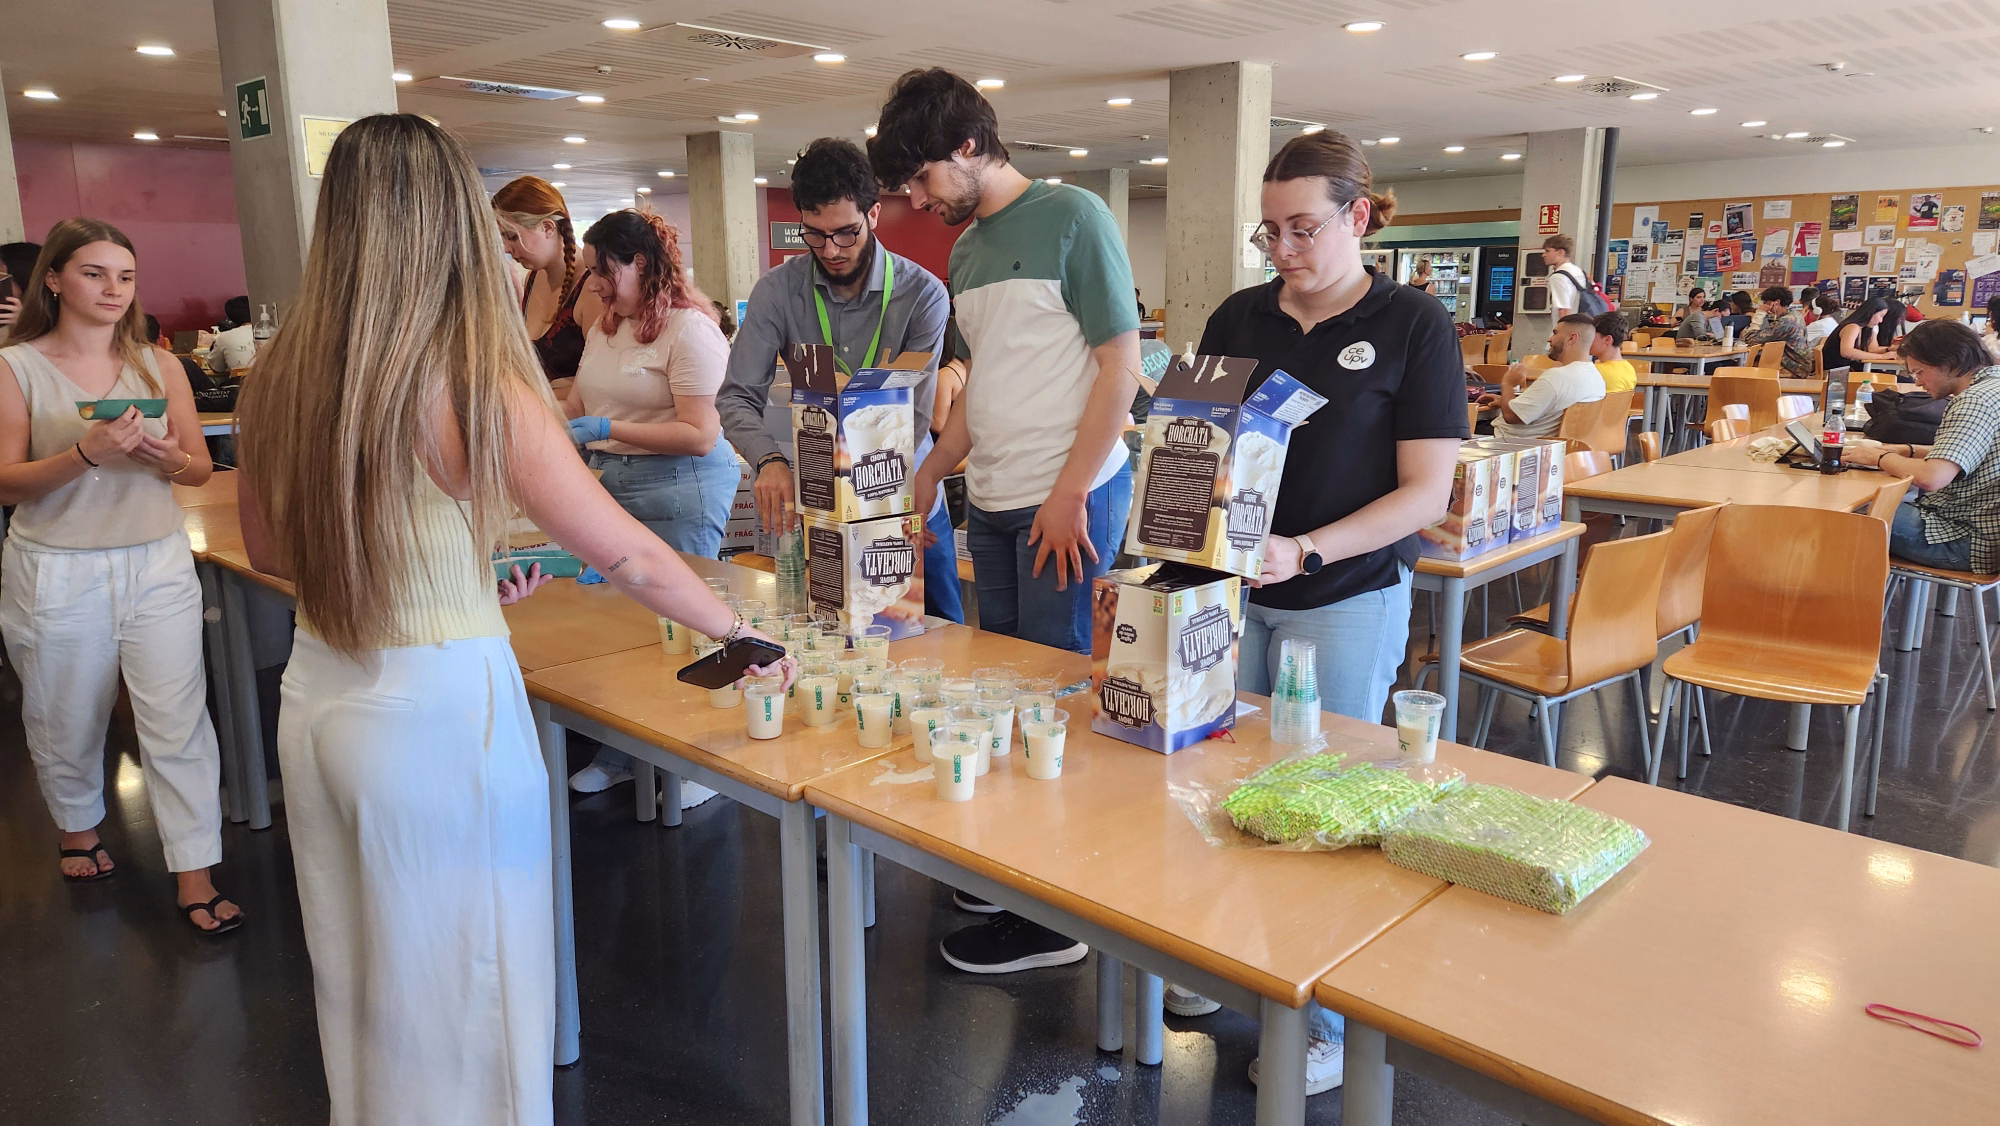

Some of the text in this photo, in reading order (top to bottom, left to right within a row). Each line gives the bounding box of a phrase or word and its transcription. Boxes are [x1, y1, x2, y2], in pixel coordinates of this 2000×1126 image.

[1167, 425, 1209, 445] HORCHATA
[854, 458, 904, 491] HORCHATA
[735, 502, 754, 510] FRÁG
[1228, 502, 1264, 535] HORCHATA
[734, 529, 755, 538] FRÁG
[864, 550, 913, 577] HORCHATA
[1181, 617, 1230, 664] HORCHATA
[764, 695, 772, 722] SUBIES
[815, 685, 823, 711] SUBIES
[1103, 686, 1150, 723] HORCHATA
[953, 754, 962, 784] SUBIES
